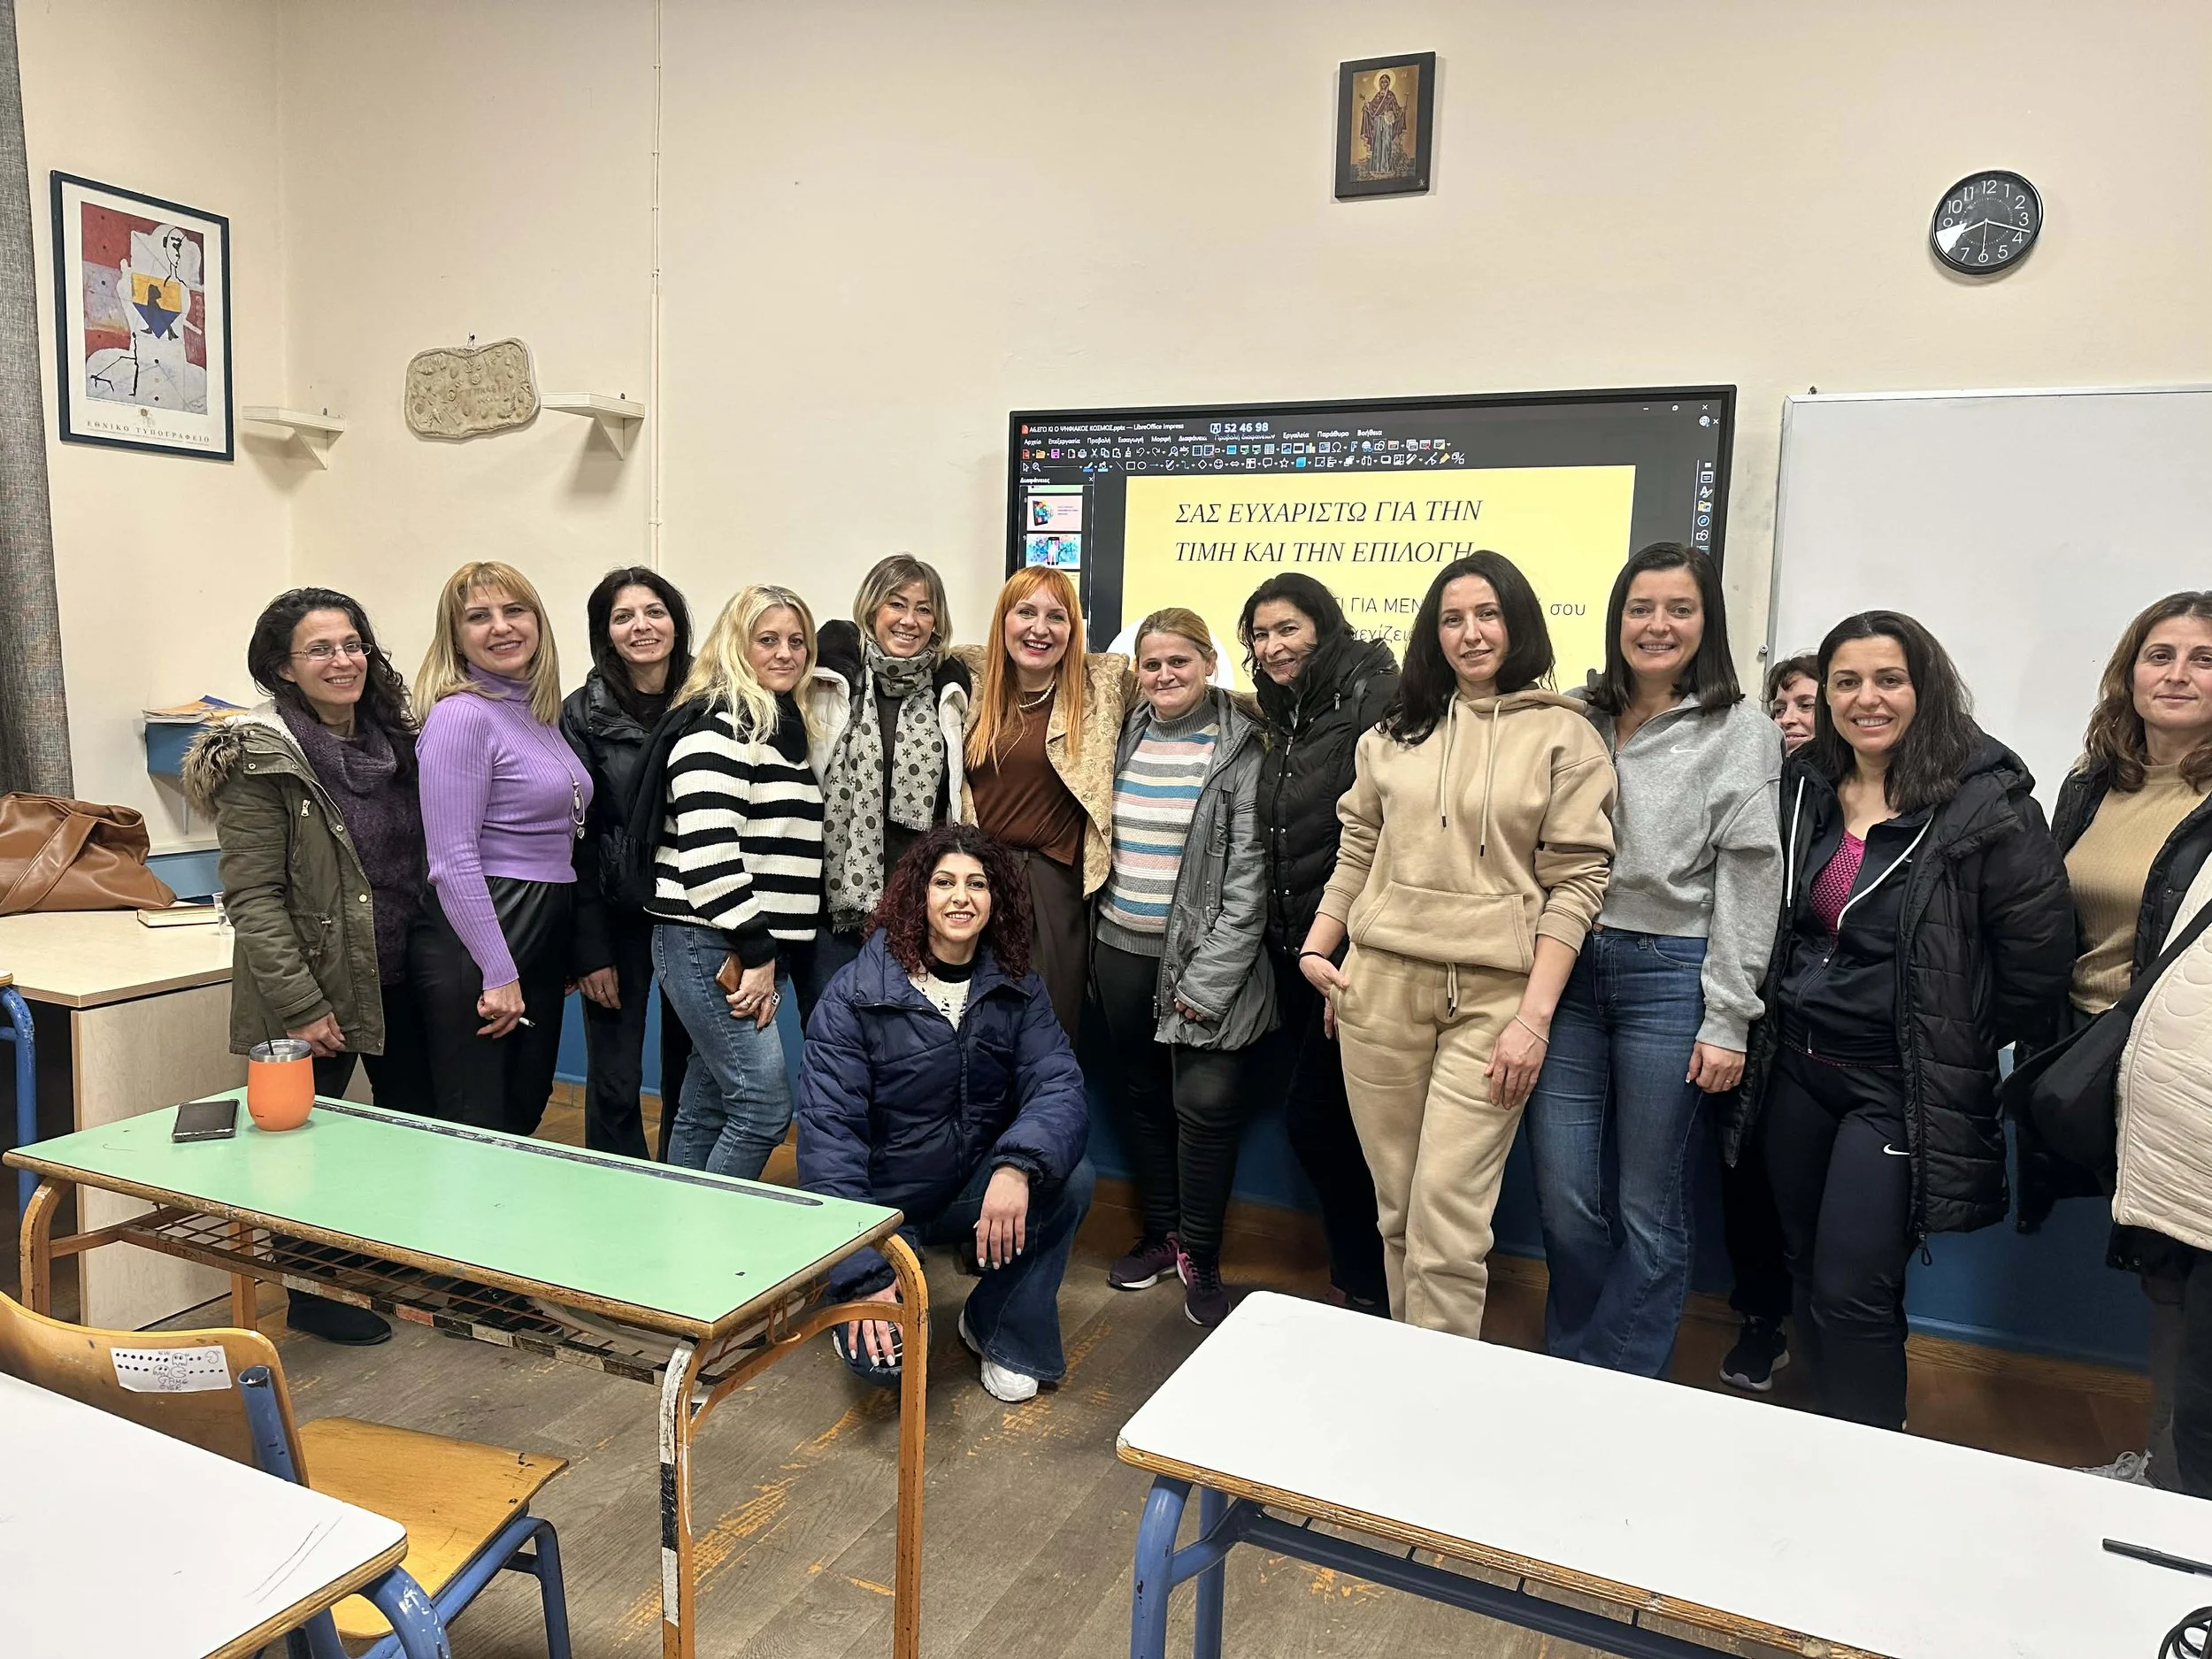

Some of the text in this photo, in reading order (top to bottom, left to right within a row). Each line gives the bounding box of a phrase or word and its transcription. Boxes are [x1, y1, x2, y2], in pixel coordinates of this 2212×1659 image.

[1963, 187, 1974, 202] 11
[1982, 180, 1997, 195] 12
[2004, 183, 2010, 198] 1
[1947, 199, 1962, 214] 10
[2015, 195, 2025, 210] 2
[2018, 211, 2029, 227] 3
[2012, 231, 2023, 243] 4
[1961, 247, 1970, 261] 7
[1978, 248, 1989, 263] 6
[1997, 244, 2008, 259] 5
[87, 420, 129, 432] ΕΘΝΙΚΟ
[136, 426, 210, 442] ΤΥΠΟΓΡΑΦΕΙΟ
[1133, 423, 1163, 432] LibreOffice
[1163, 423, 1184, 432] Impress
[1224, 422, 1269, 434] 52 46 98
[1175, 499, 1484, 524] ΣΑΣ ΕΥΧΑΡΙΣΤΩ ΓΙΑ ΤΗΝ
[1175, 541, 1475, 564] ΤΙΜΗ ΚΑΙ ΤΗΝ ΕΠΙΛΟΓΗ
[1350, 597, 1378, 613] ΓΙΑ
[1384, 597, 1424, 614] ΜΕΝ
[1550, 603, 1586, 616] σου
